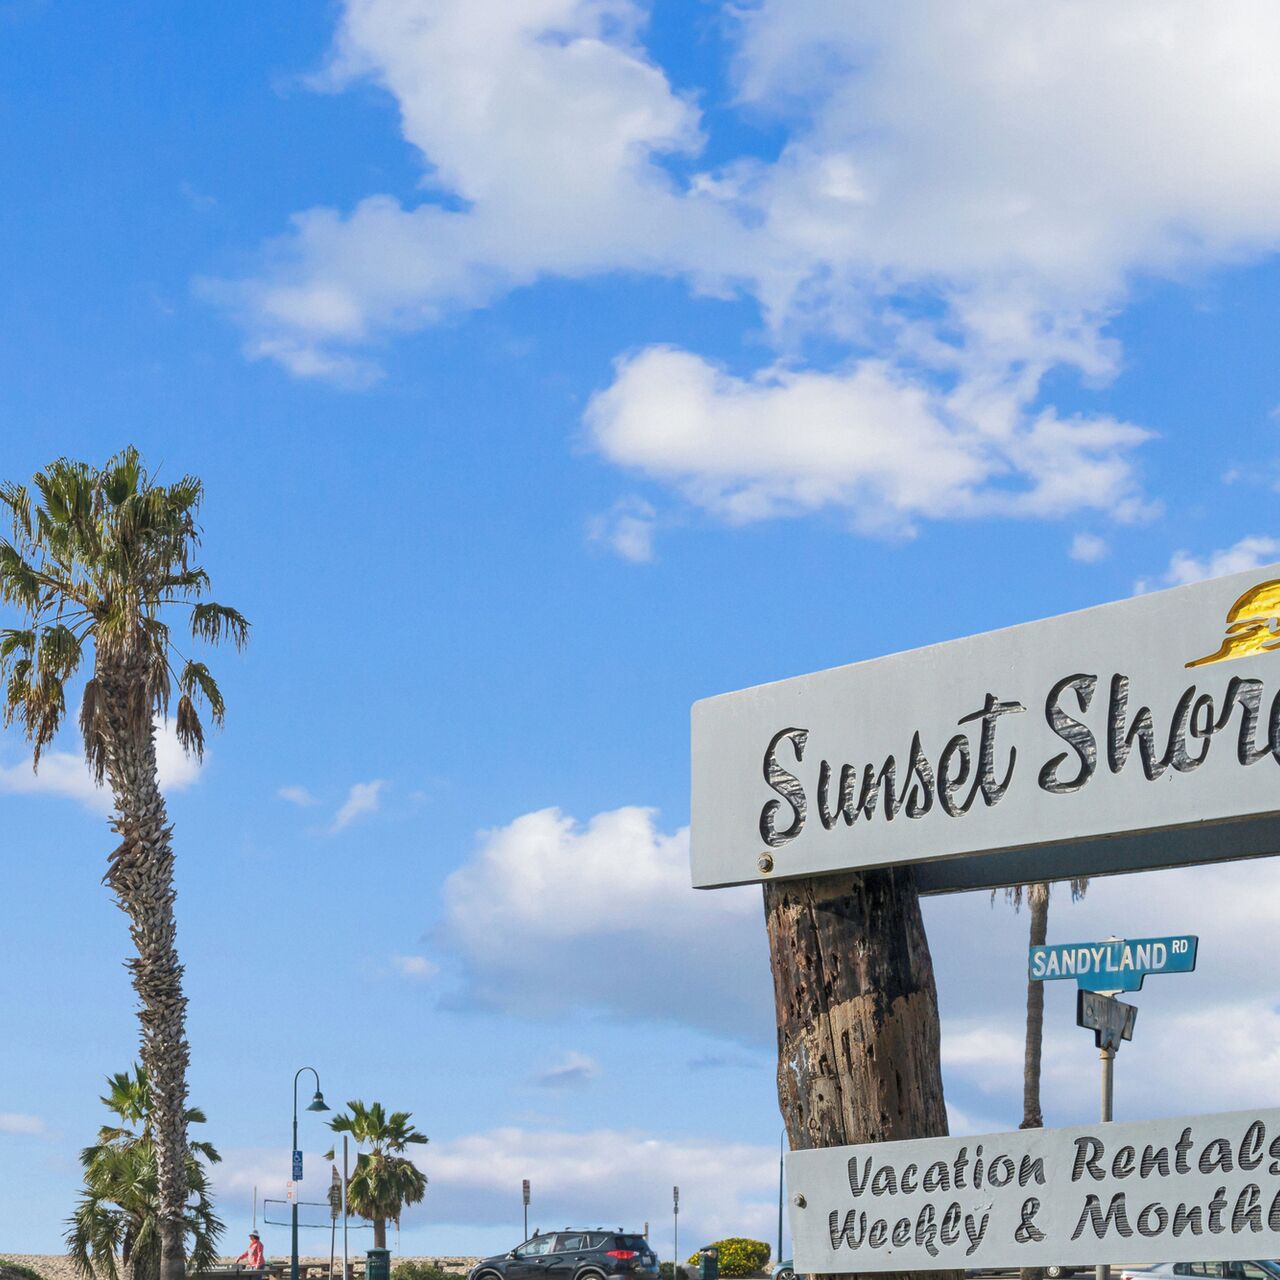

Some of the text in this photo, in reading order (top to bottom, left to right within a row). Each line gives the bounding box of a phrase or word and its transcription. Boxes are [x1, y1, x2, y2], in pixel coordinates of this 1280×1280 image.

[759, 692, 1027, 848] Sunset
[1032, 939, 1189, 977] SANDYLAND RD
[847, 1144, 1046, 1198] Vacation
[828, 1201, 990, 1257] Weekly
[1013, 1196, 1047, 1244] &
